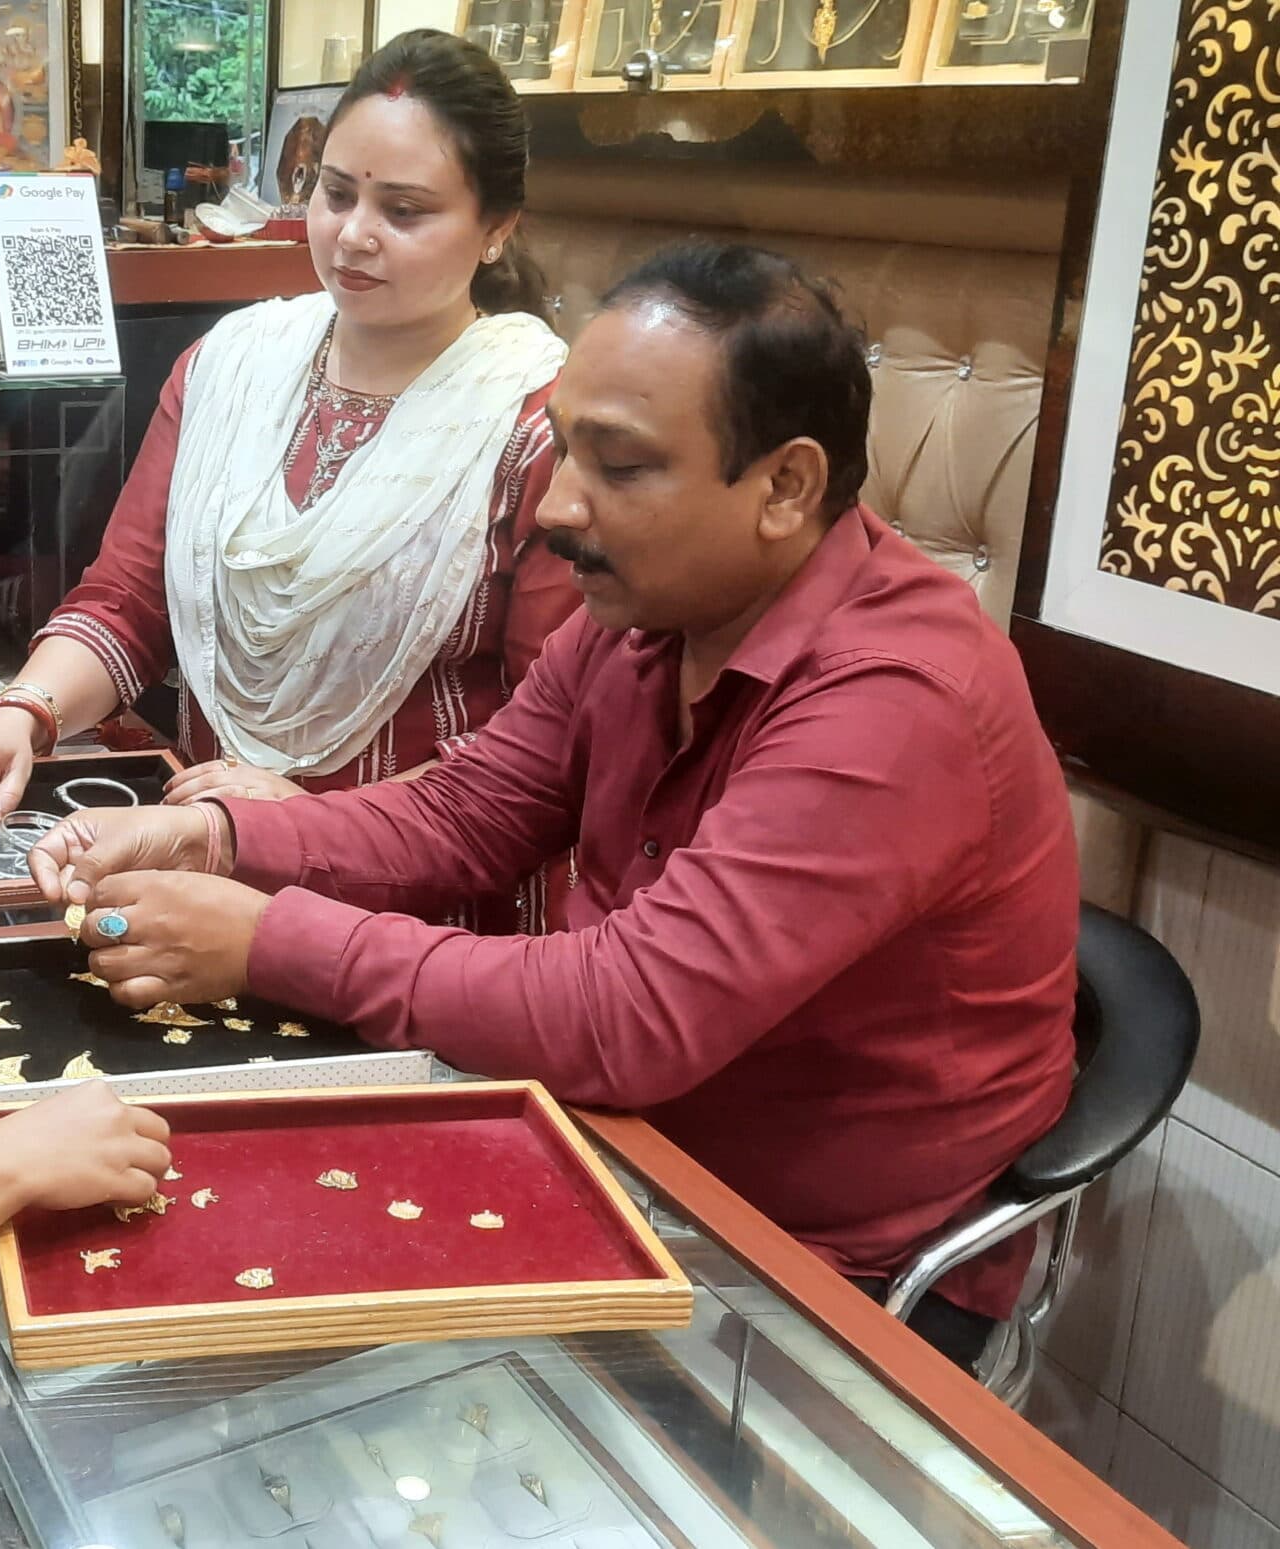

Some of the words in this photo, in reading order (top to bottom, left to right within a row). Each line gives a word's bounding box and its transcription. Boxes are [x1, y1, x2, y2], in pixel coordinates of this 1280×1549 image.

[19, 186, 63, 201] Google
[65, 186, 85, 201] Pay
[17, 339, 62, 350] BHIM
[74, 338, 103, 348] UPI
